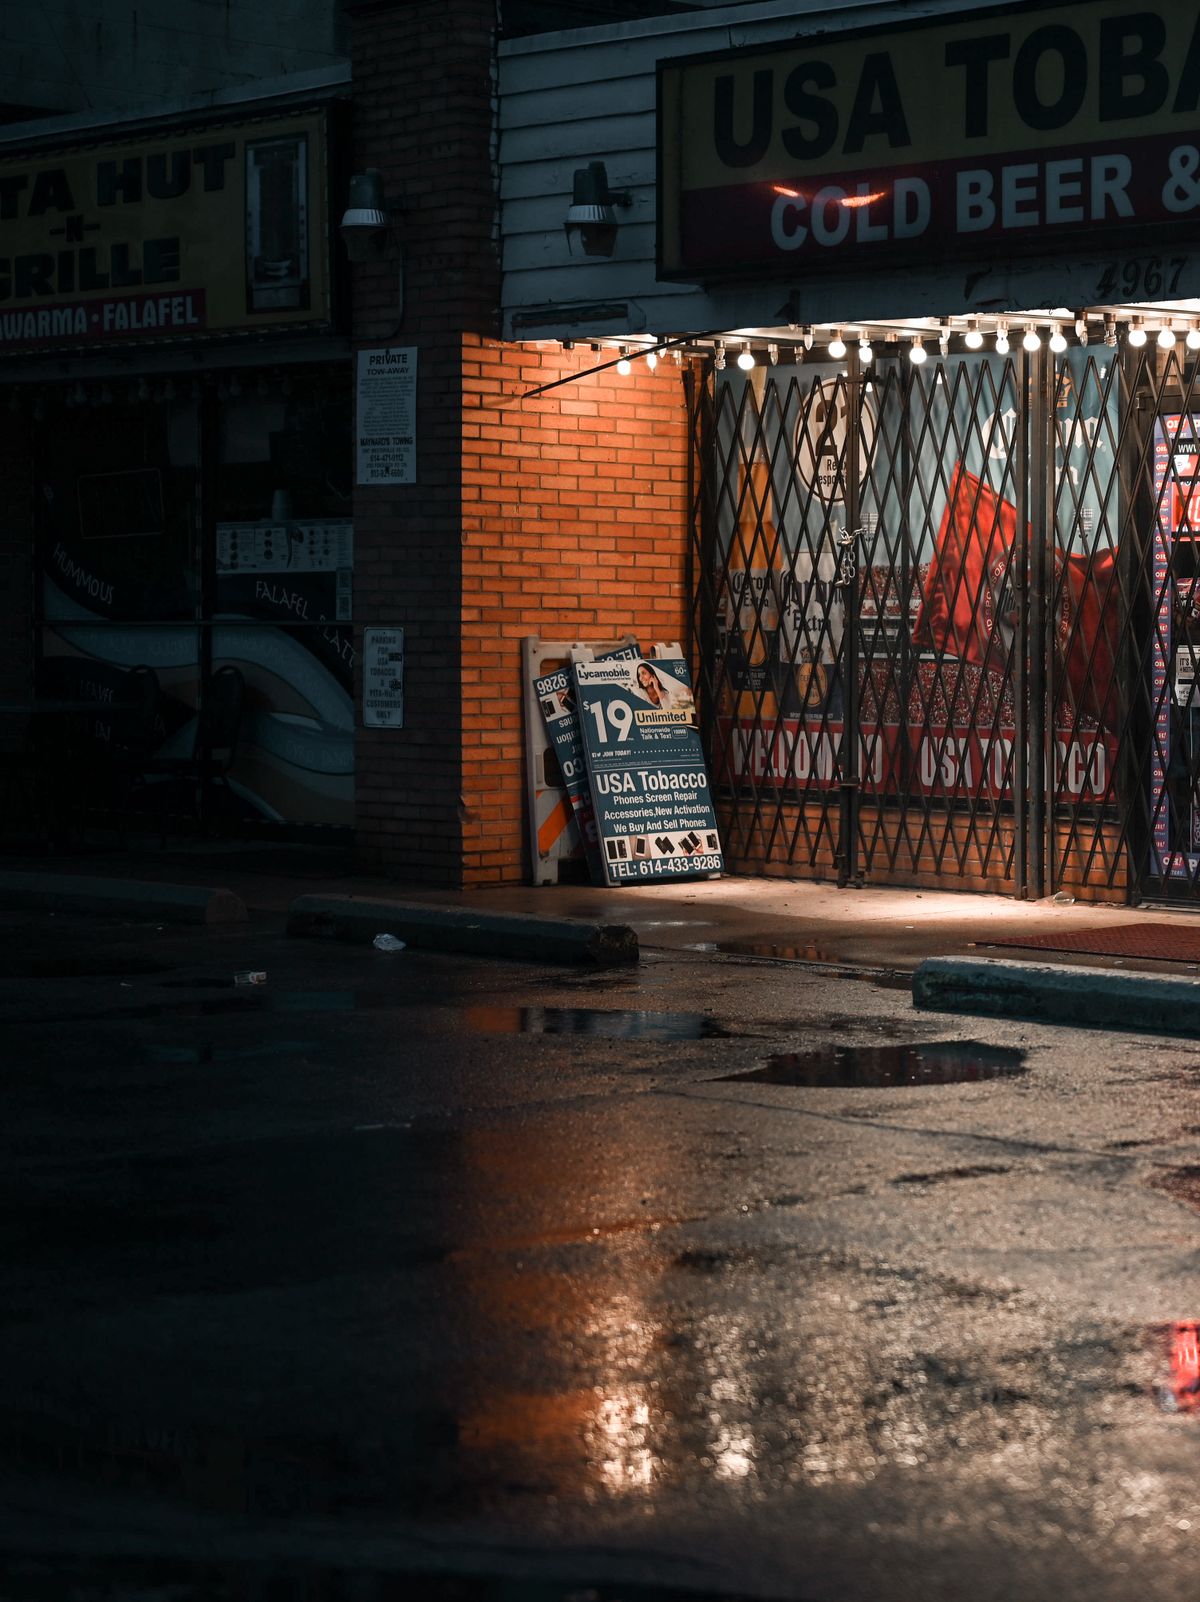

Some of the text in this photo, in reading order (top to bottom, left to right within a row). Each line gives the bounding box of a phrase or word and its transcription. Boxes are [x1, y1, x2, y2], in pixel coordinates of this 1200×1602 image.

[714, 52, 912, 168] USA
[97, 142, 236, 206] HUT
[770, 177, 931, 252] COLD
[956, 152, 1134, 235] BEER
[0, 237, 180, 301] RILLE
[1096, 256, 1186, 298] 4967
[0, 295, 199, 341] WARMA FALAFEL
[367, 367, 409, 376] TOW-AWAY
[369, 354, 408, 366] PRIVATE
[256, 580, 309, 620] FALAFEL
[371, 635, 397, 644] PARKING
[578, 668, 630, 680] Lycamobile
[637, 711, 687, 723] Unlimited
[732, 728, 845, 782] WELCOM
[920, 736, 973, 788] USA
[596, 770, 707, 794] USA Tobacco
[613, 790, 698, 805] Phones Screen Repair
[674, 803, 710, 815] Activation
[613, 818, 707, 834] We Buy And Sell Phones
[609, 855, 721, 878] TEL: 614-433-9286
